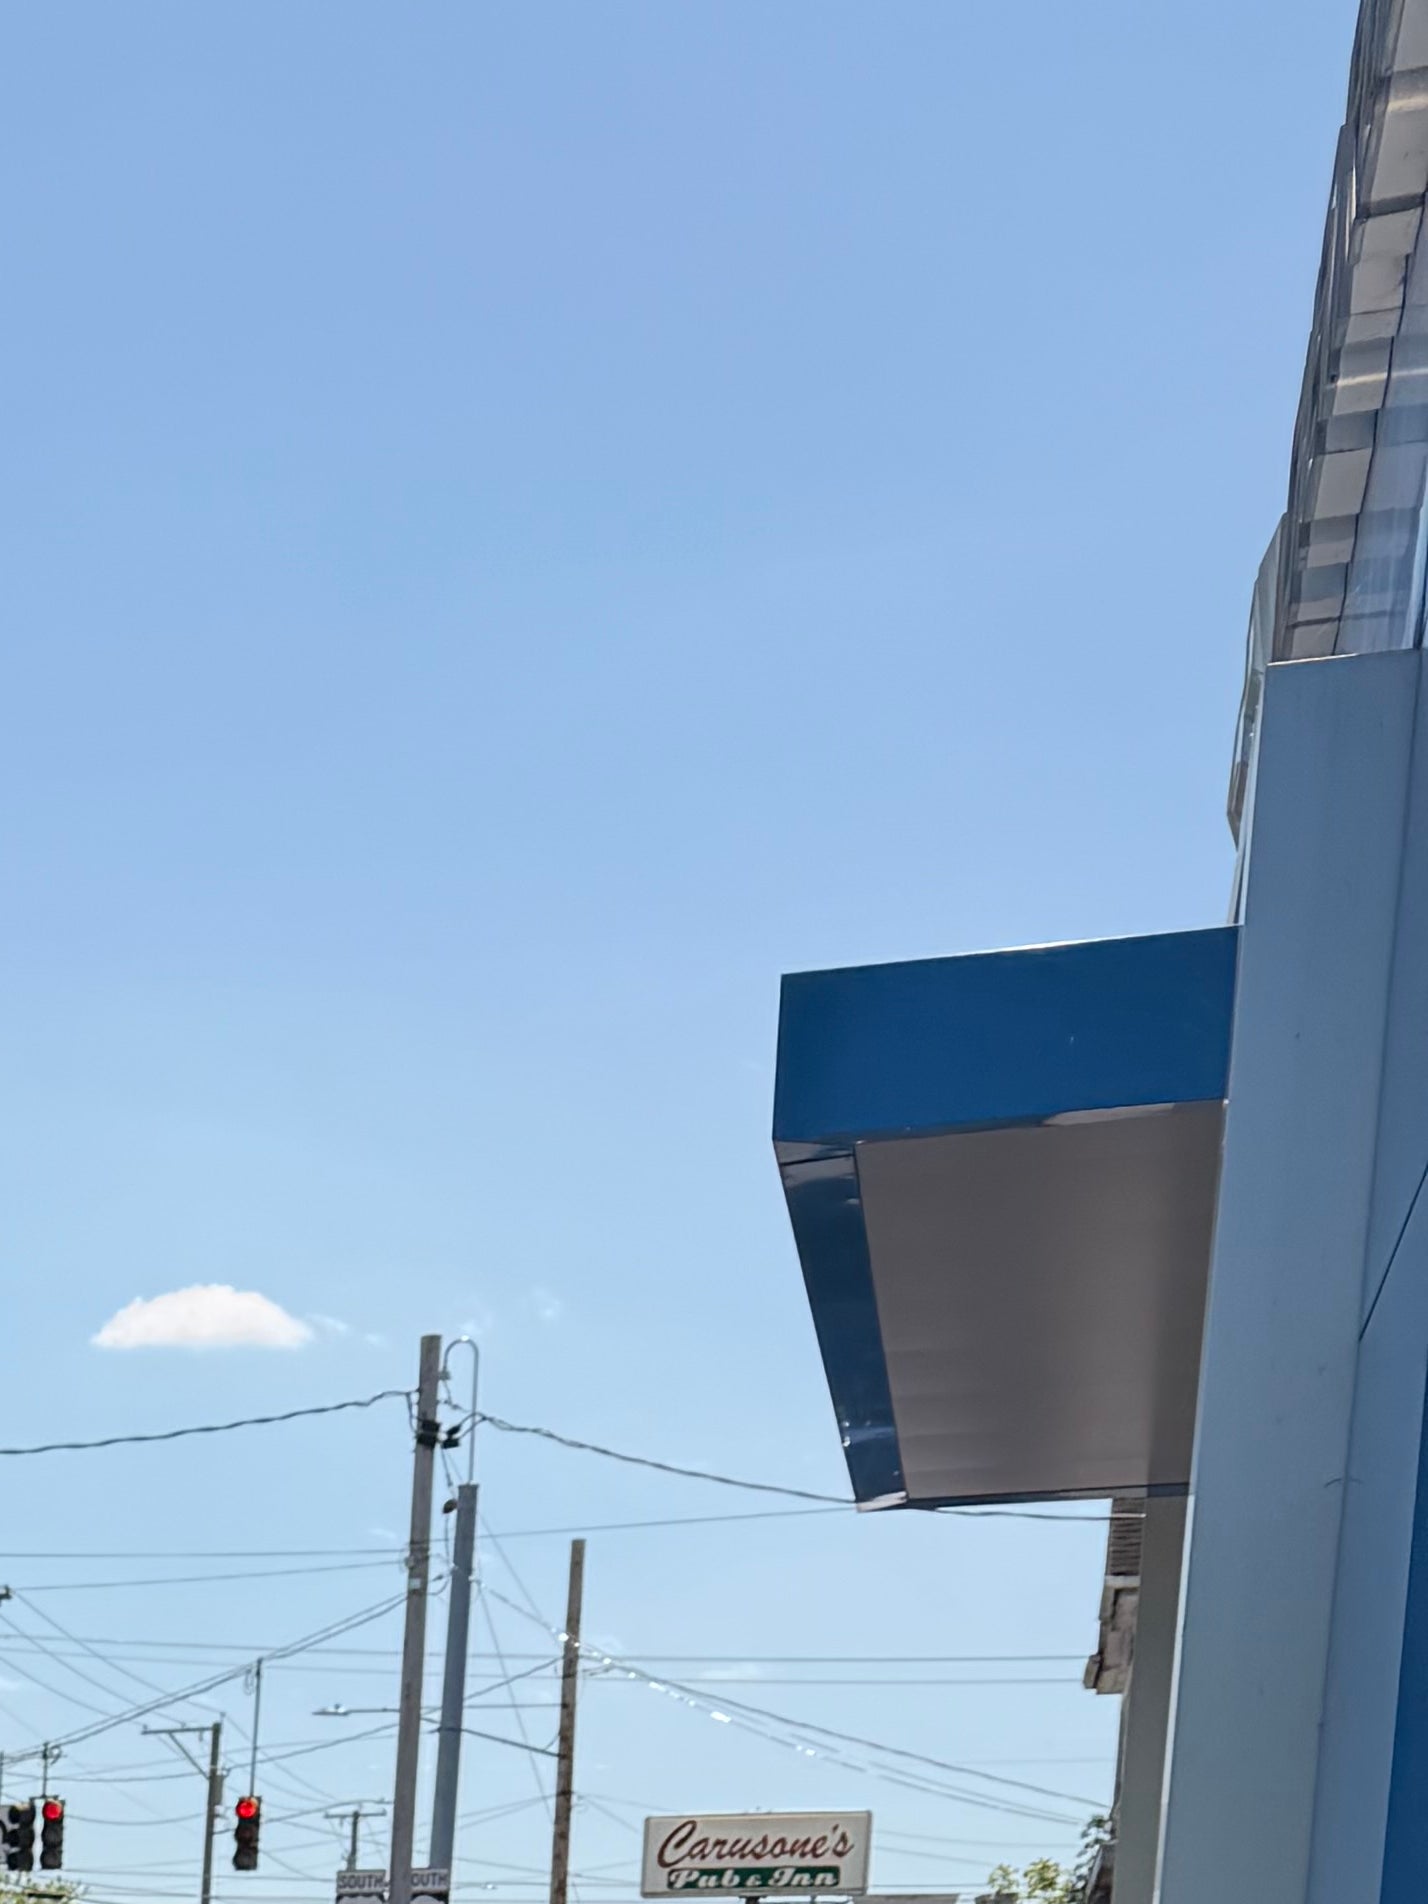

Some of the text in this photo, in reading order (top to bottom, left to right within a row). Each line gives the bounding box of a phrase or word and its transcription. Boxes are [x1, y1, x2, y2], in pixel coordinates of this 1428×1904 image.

[657, 1820, 855, 1868] Carusone's
[339, 1874, 384, 1889] SOUTH
[410, 1872, 448, 1887] OUTH
[669, 1870, 741, 1888] Pub
[768, 1868, 837, 1887] Inn
